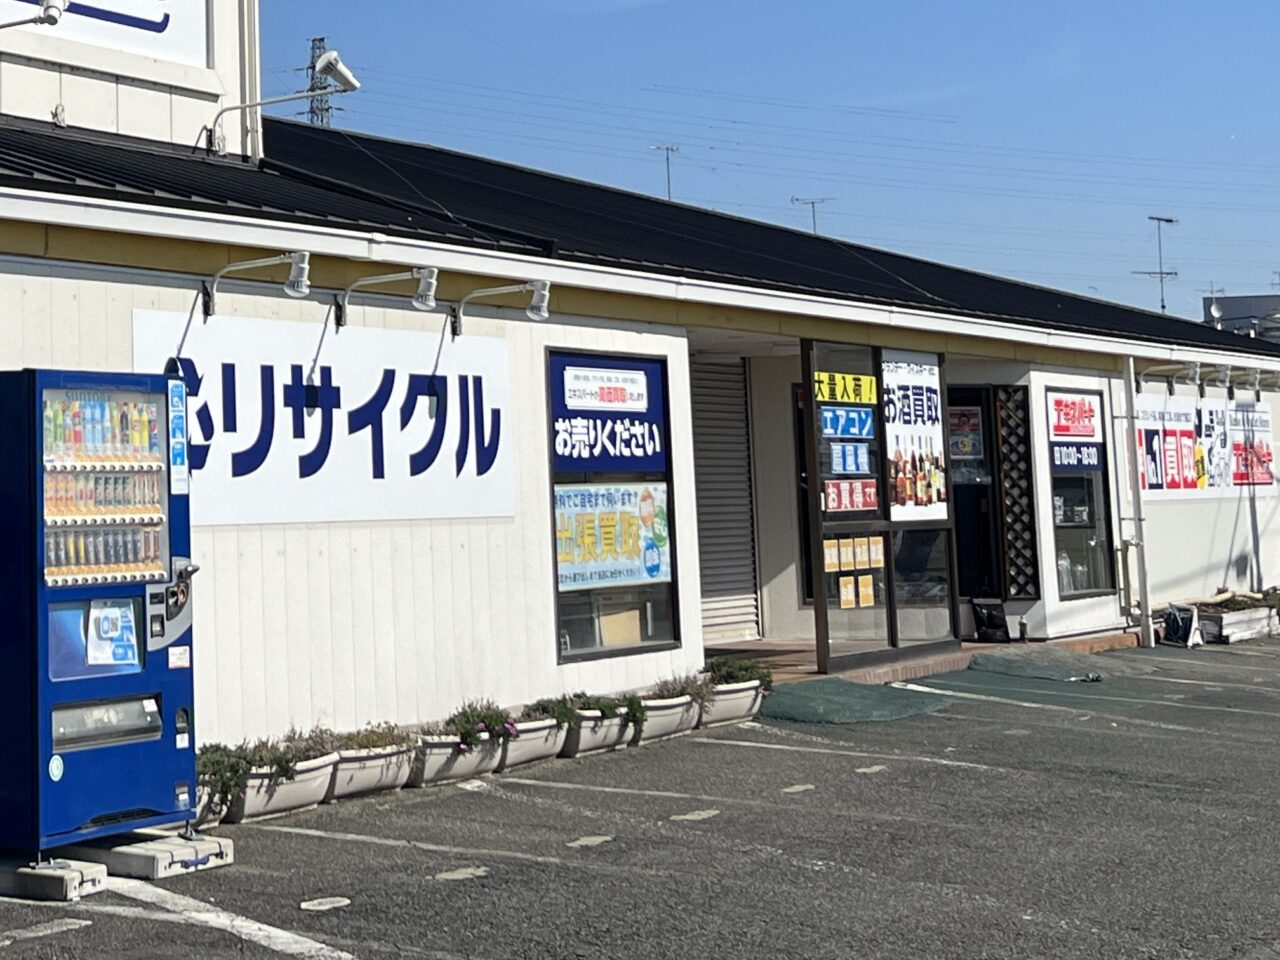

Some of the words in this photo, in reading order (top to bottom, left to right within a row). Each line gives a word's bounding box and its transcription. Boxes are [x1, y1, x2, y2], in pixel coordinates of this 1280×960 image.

[221, 362, 501, 480] リサイクル
[823, 410, 872, 436] エアコン
[883, 383, 940, 426] お酒買取
[554, 416, 660, 459] お売りください
[556, 512, 641, 564] 出張買取
